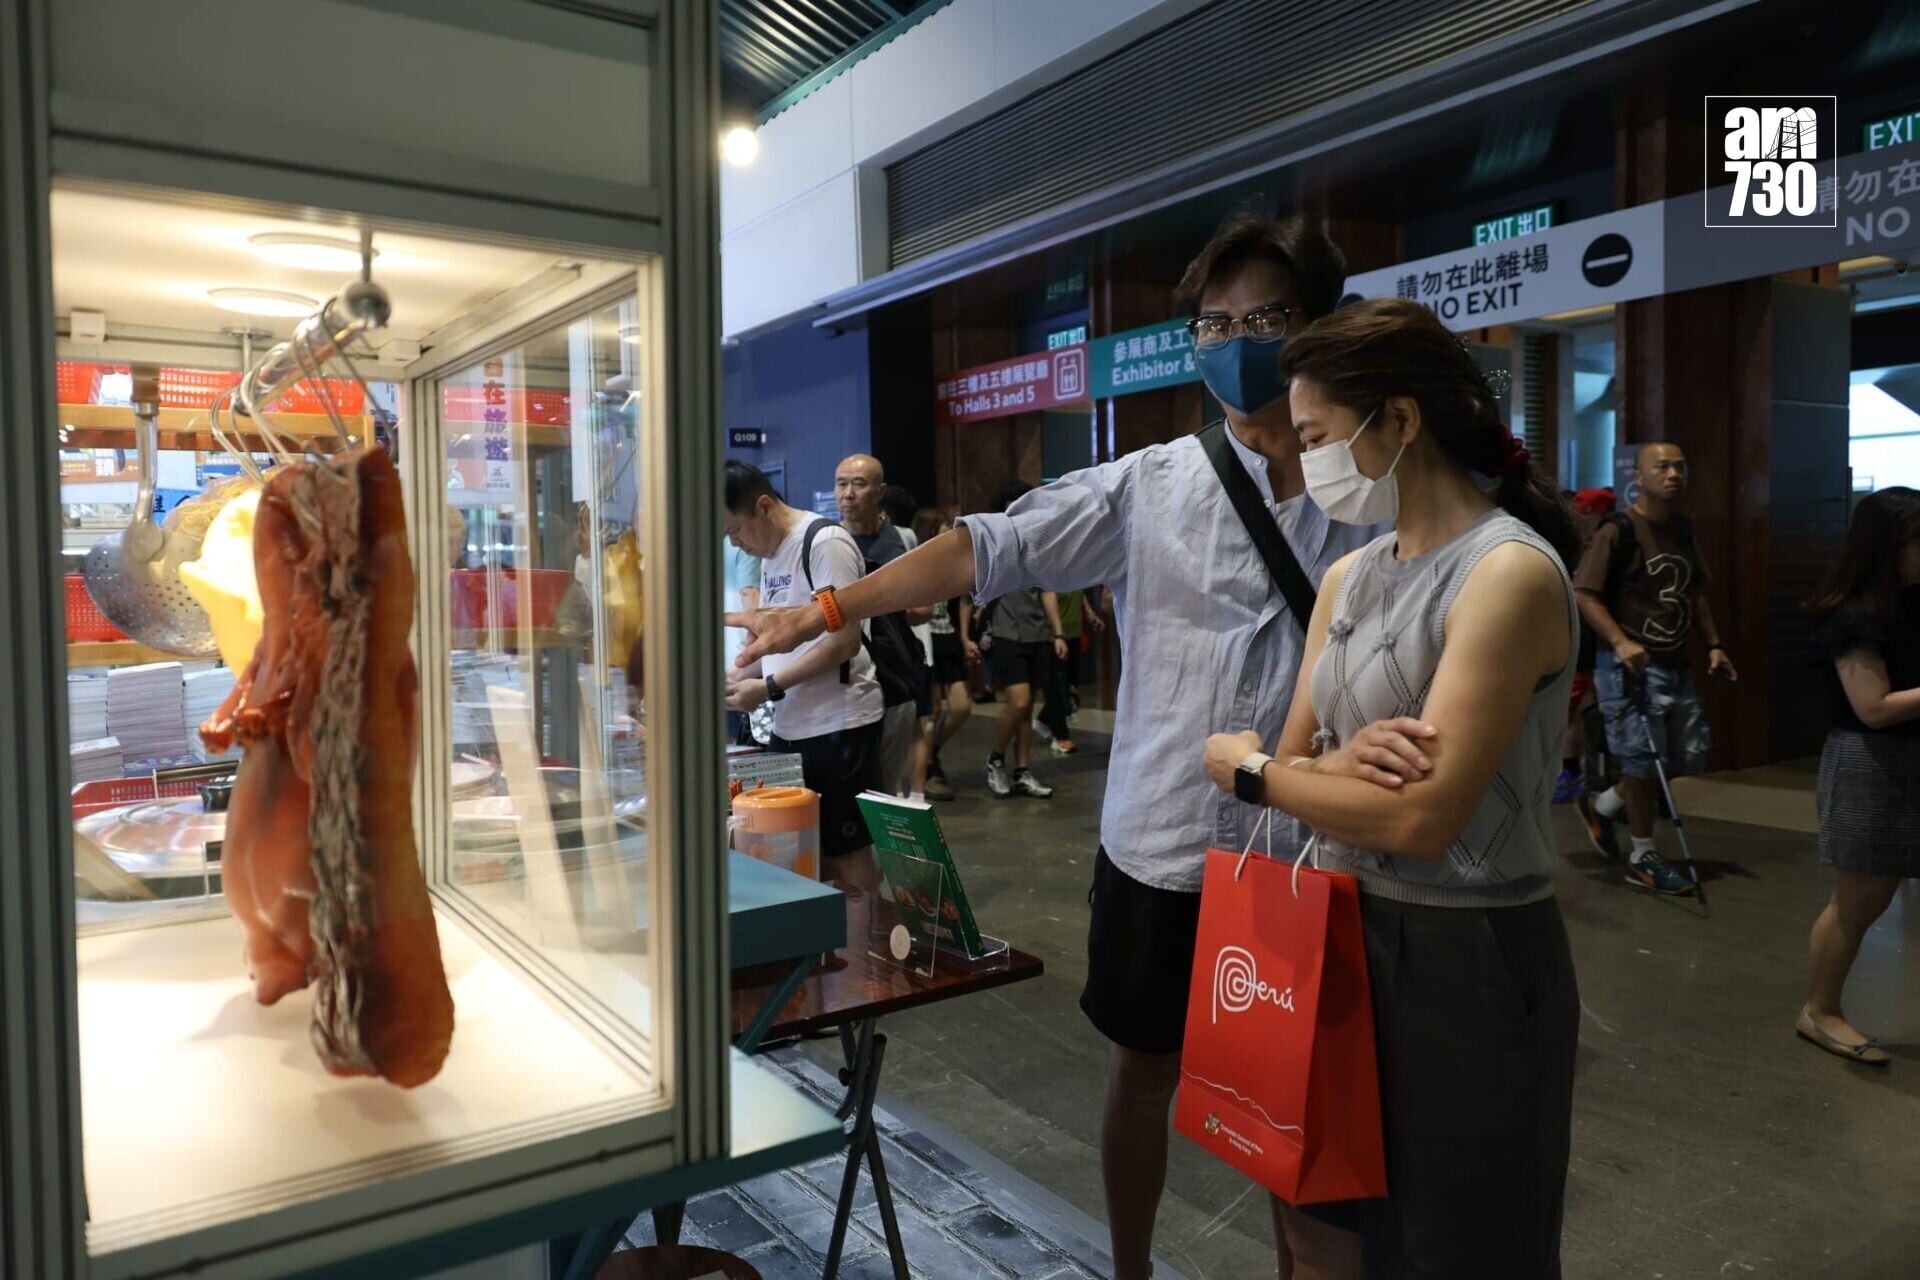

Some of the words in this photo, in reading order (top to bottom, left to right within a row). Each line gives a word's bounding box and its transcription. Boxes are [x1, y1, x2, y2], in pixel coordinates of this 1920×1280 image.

[1475, 217, 1515, 246] EXIT
[1517, 207, 1550, 237] 出口
[1846, 206, 1911, 246] NO
[1396, 243, 1549, 300] 請勿在此離場
[1467, 283, 1523, 315] EXIT
[1048, 331, 1068, 350] EXIT
[1113, 327, 1195, 363] 參展商及工
[1112, 359, 1182, 386] Exhibitor
[1184, 351, 1196, 372] &
[948, 400, 962, 416] To
[964, 395, 991, 414] Halls
[993, 392, 1001, 408] 3
[1003, 387, 1024, 406] and
[1026, 385, 1035, 402] 5
[1642, 553, 1692, 651] 3
[1212, 946, 1295, 1024] Perú
